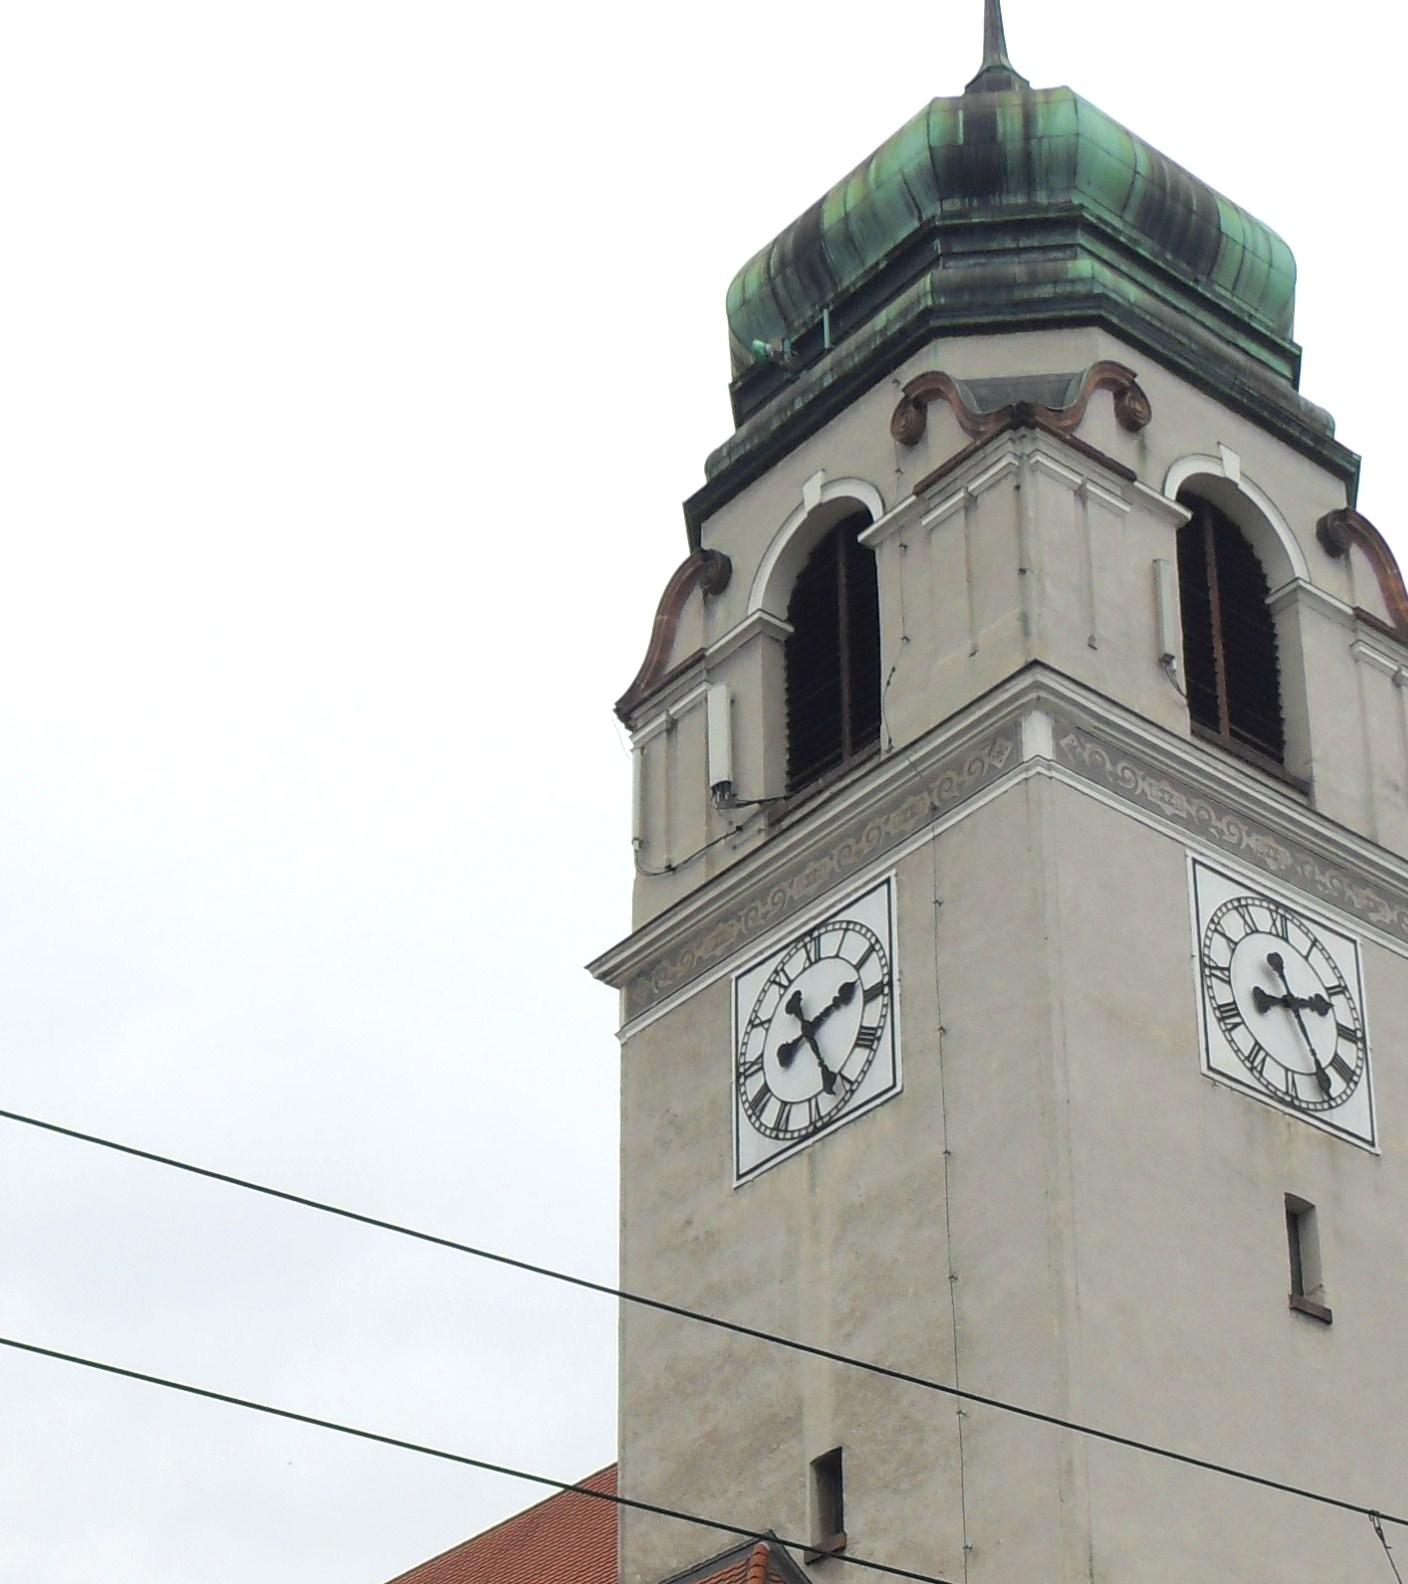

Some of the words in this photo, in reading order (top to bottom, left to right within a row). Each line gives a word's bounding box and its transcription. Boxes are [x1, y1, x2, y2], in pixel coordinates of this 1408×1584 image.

[1234, 905, 1258, 934] XI
[1269, 909, 1289, 942] XII
[1214, 921, 1237, 952] X
[803, 934, 821, 968] XII
[854, 944, 874, 971] II
[770, 966, 793, 997] XI
[1209, 957, 1230, 985] IX
[863, 982, 883, 1005] III
[1325, 983, 1346, 997] II
[750, 1015, 772, 1032] X
[1337, 1022, 1357, 1043] III
[742, 1052, 764, 1079] IX
[1245, 1041, 1268, 1076] VII
[1285, 1070, 1298, 1100] VI
[774, 1102, 792, 1131] VII
[808, 1098, 823, 1122] VI
